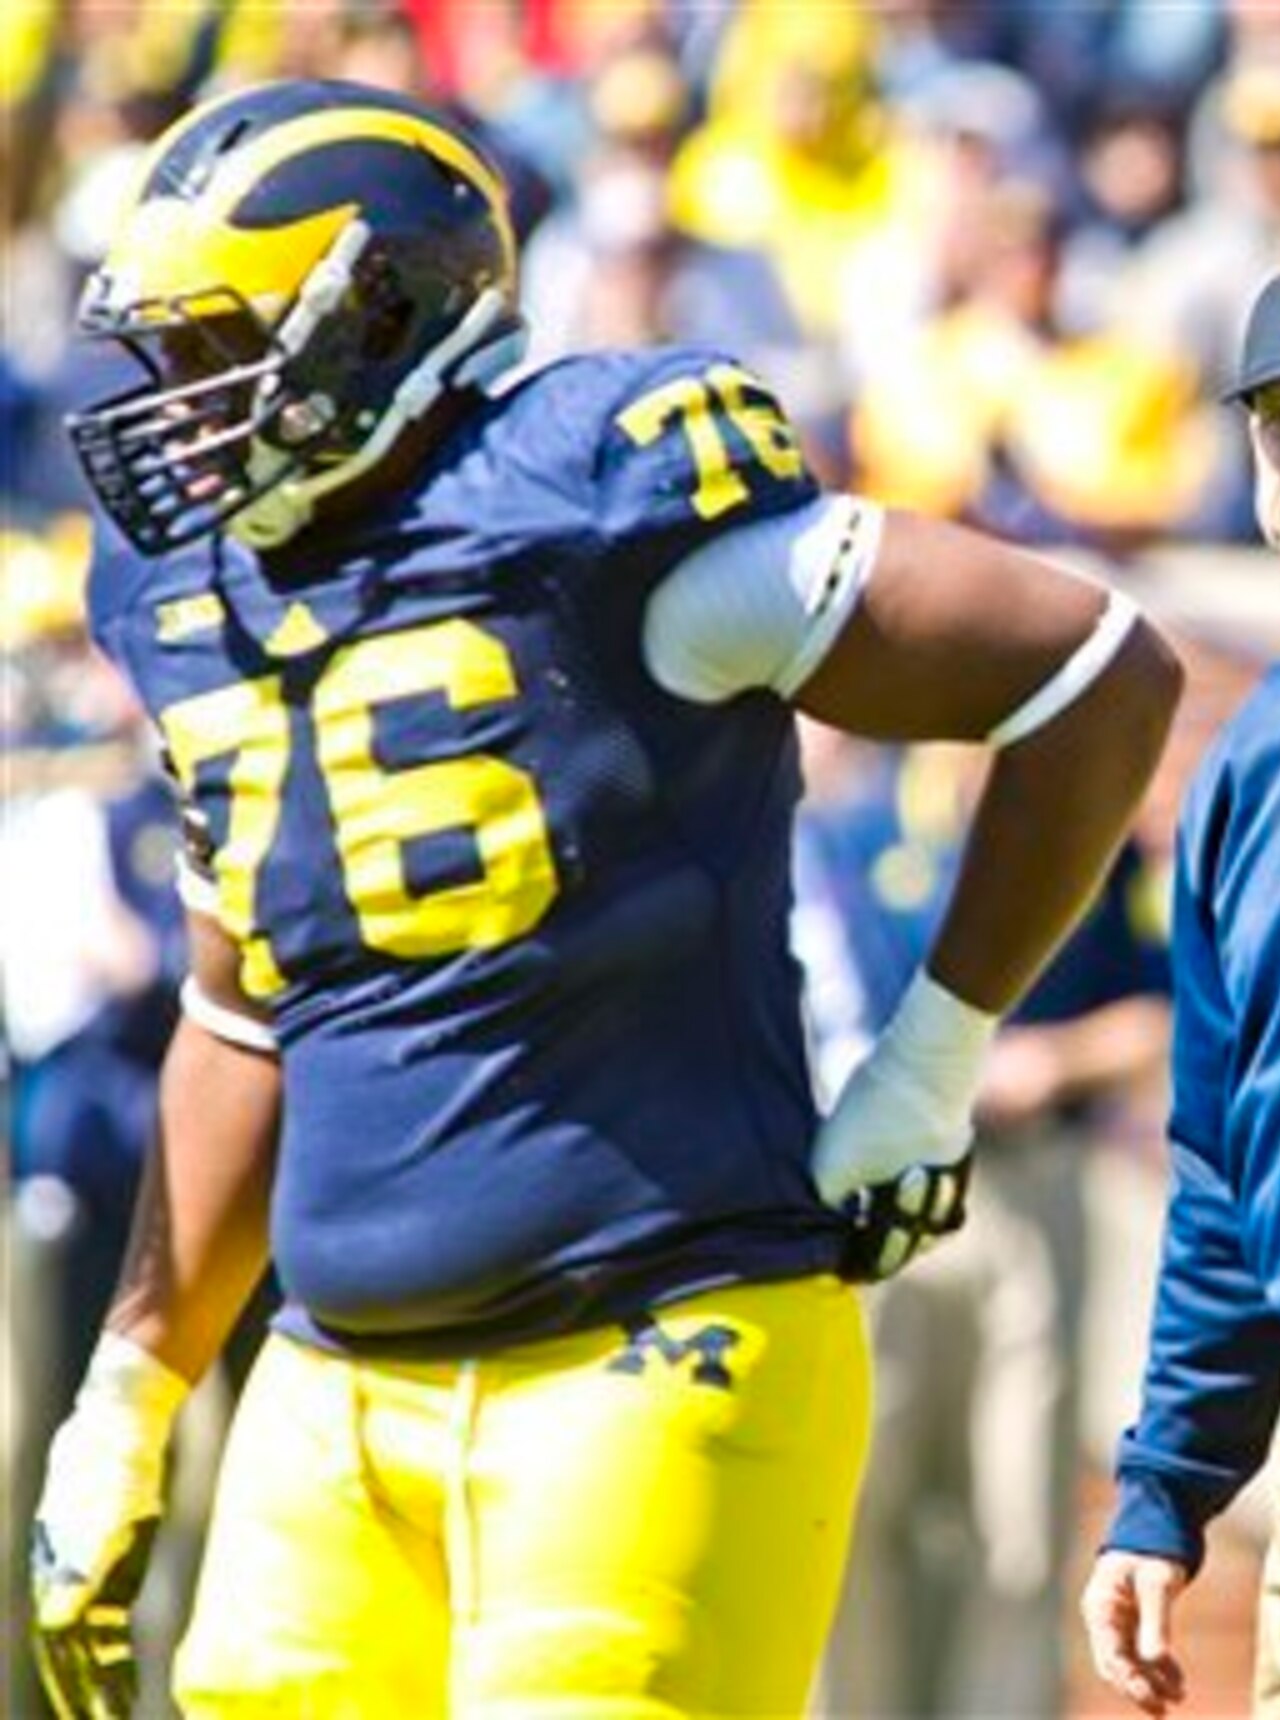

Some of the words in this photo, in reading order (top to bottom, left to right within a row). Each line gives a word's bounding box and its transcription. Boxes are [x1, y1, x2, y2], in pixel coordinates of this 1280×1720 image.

[615, 363, 803, 520] 76
[160, 617, 560, 997] 76
[606, 1318, 741, 1390] M
